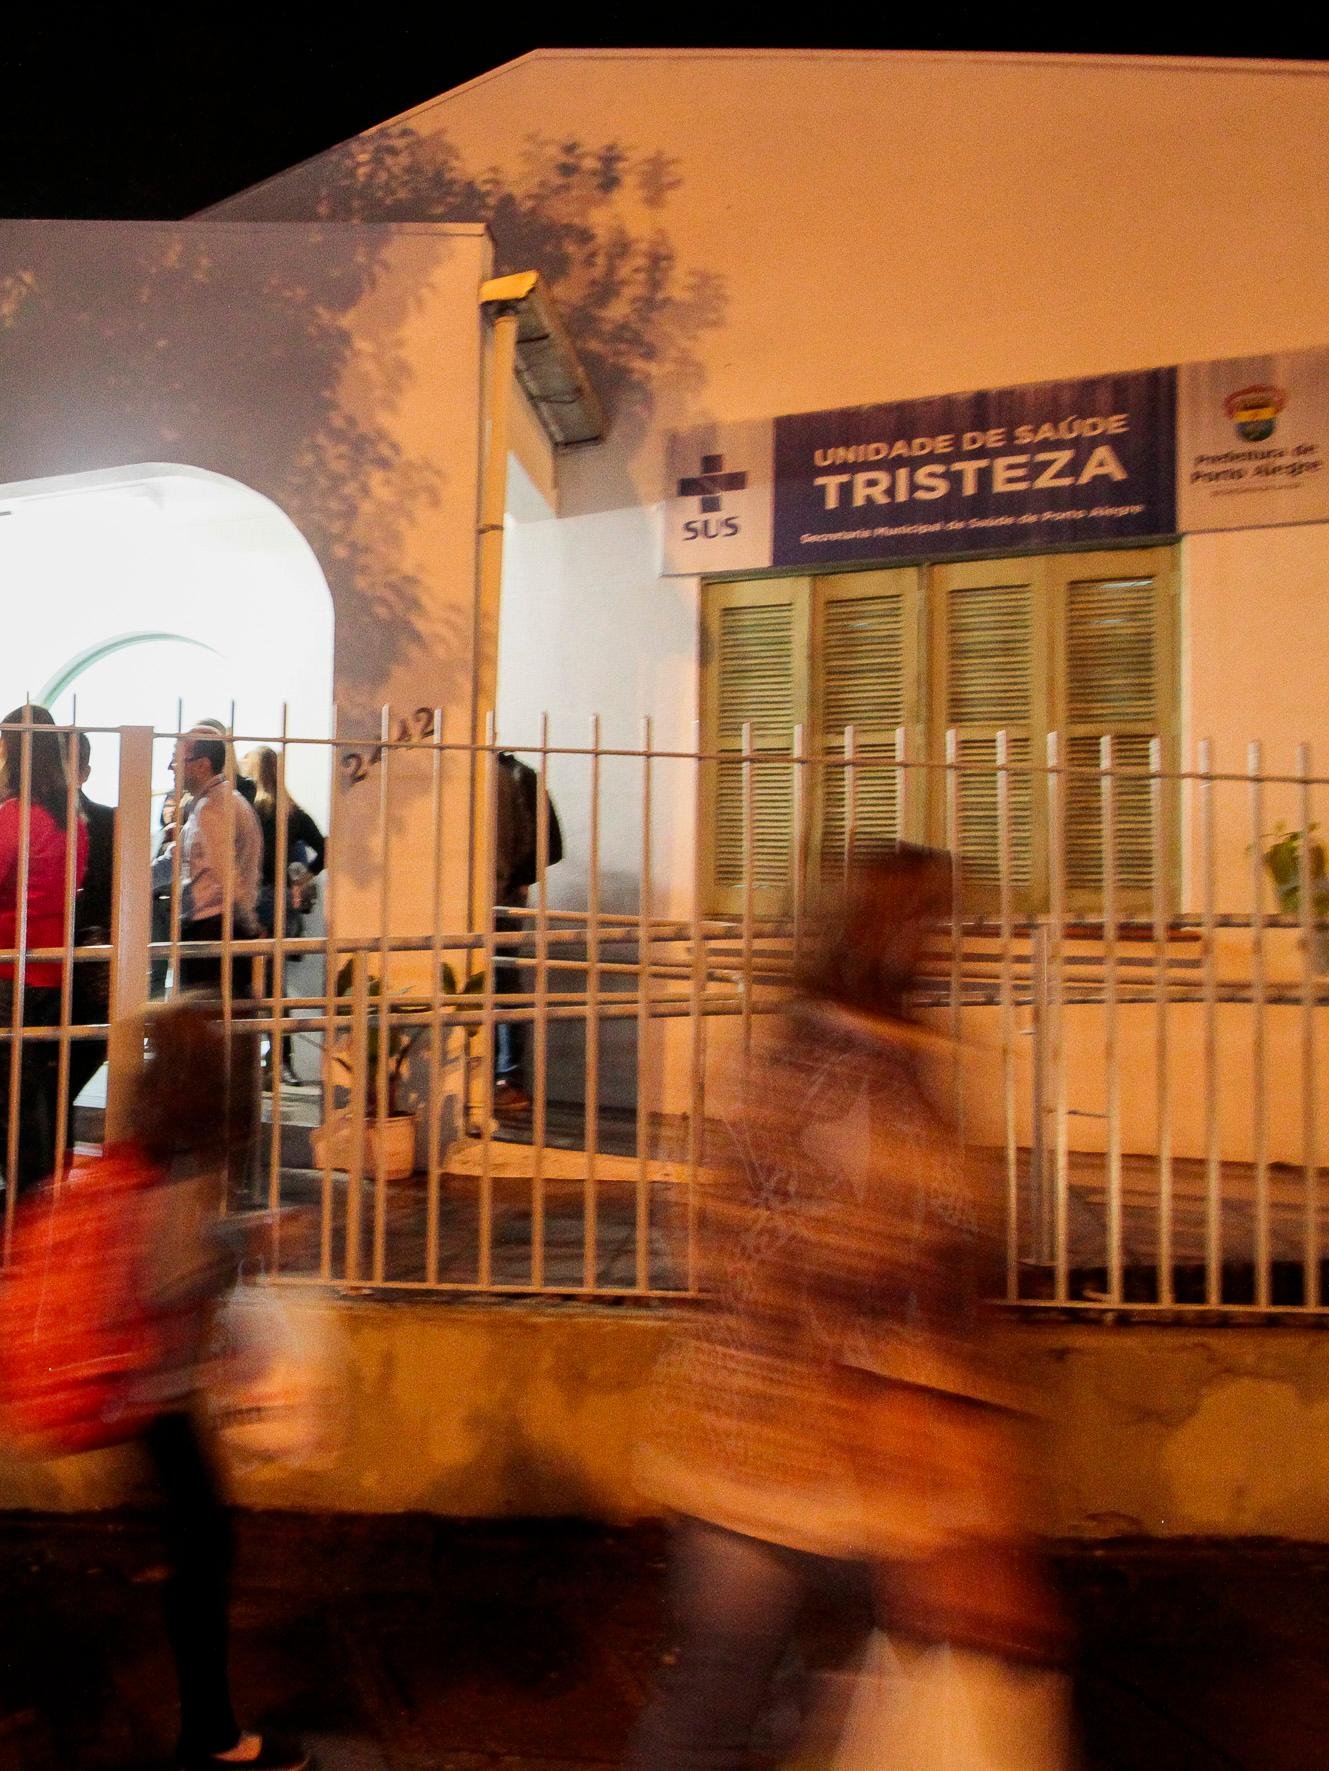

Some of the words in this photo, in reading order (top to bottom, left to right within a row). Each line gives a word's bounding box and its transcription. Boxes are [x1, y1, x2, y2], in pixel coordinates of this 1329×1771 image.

[813, 433, 955, 467] UNIDADE
[961, 427, 1007, 451] DE
[1013, 414, 1130, 446] SAÚDE
[813, 444, 1128, 510] TRISTEZA
[1190, 467, 1246, 485] Porto
[682, 516, 740, 541] SUS
